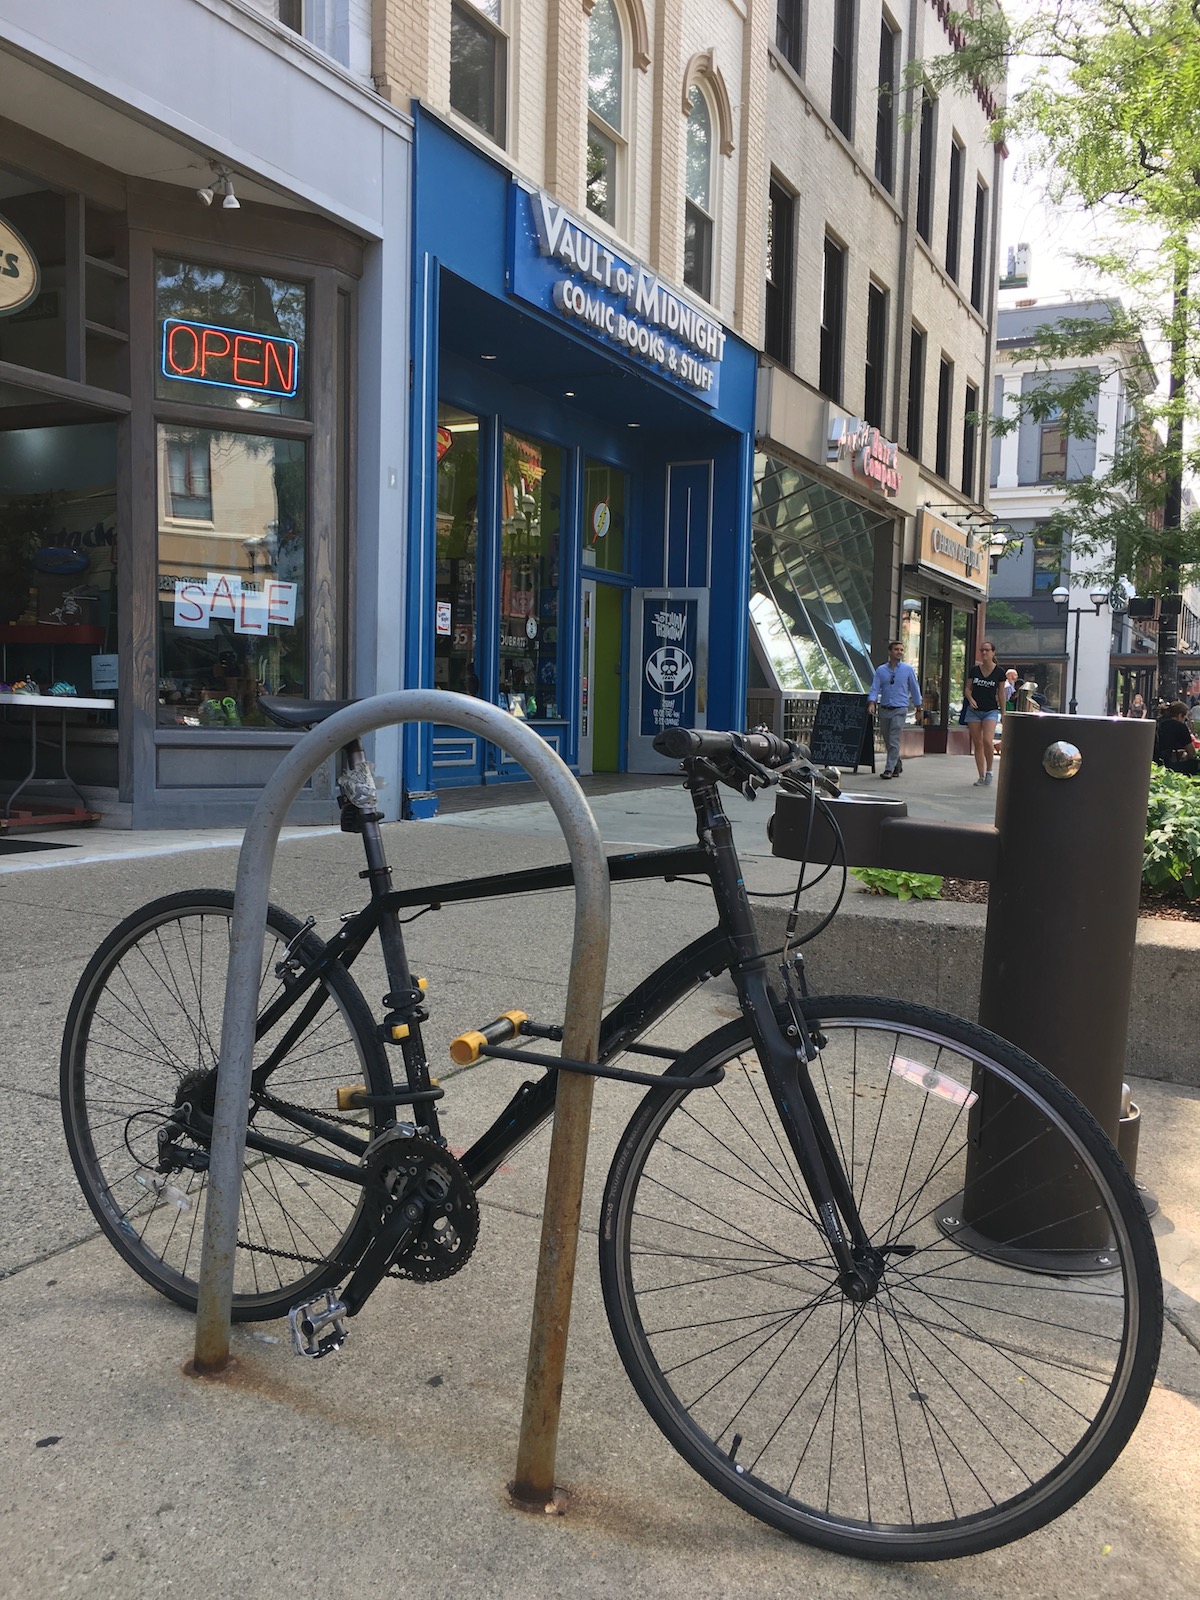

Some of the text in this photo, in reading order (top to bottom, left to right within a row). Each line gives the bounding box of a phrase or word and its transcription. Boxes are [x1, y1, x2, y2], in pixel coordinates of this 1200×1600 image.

[539, 190, 726, 361] VAULT OF MIDNIGHT
[168, 325, 293, 391] OPEN
[562, 280, 714, 391] COMIC BOOKS & STUFF
[179, 575, 292, 629] SALE
